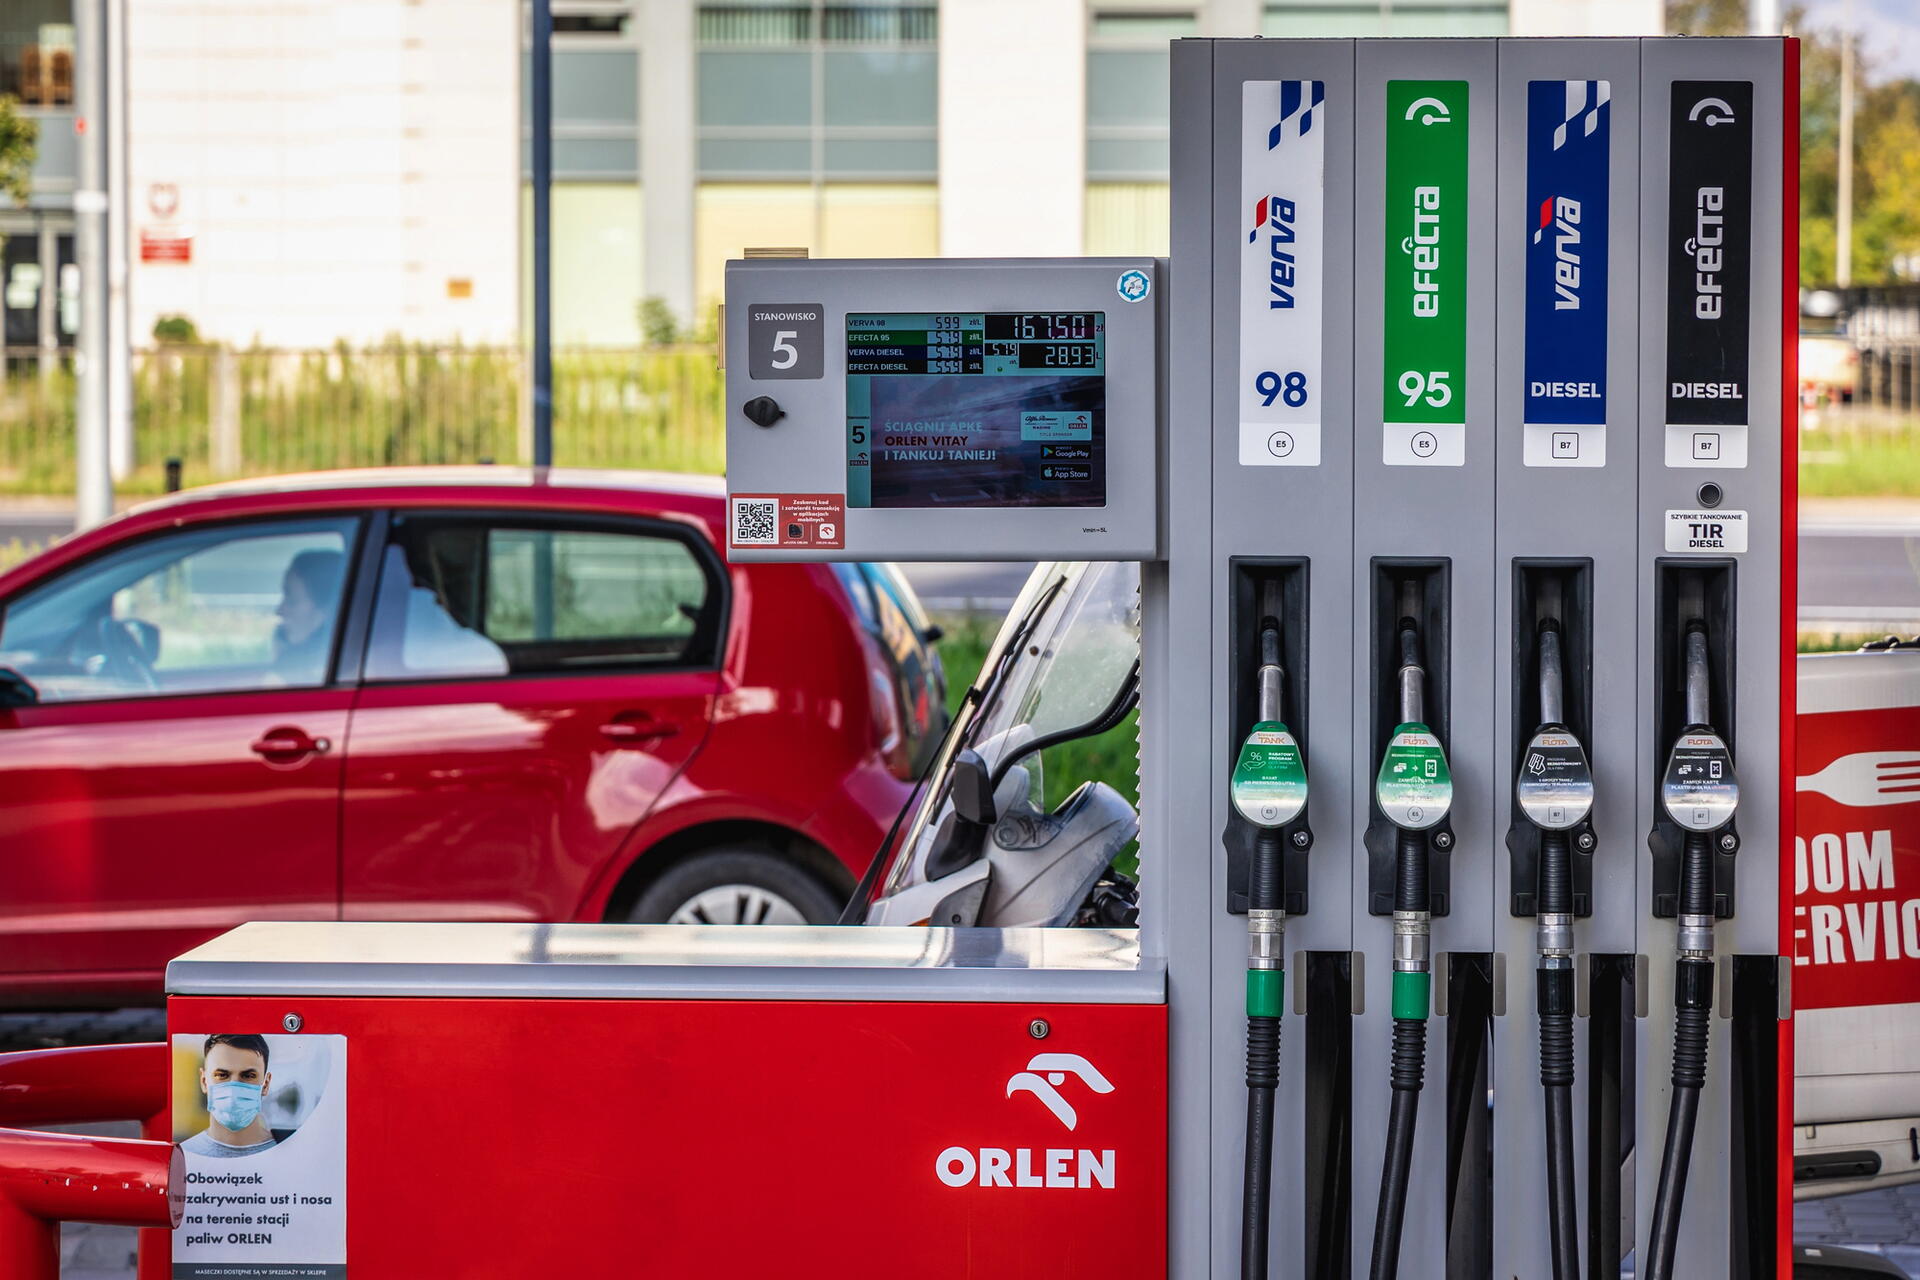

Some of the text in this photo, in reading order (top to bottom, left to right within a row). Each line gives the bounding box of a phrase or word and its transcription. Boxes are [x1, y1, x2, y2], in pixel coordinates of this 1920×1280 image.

[1270, 196, 1295, 310] verva
[1555, 196, 1581, 310] verva
[754, 312, 817, 321] STANOWISKO
[848, 319, 875, 327] VERVA
[771, 330, 798, 370] 5
[848, 348, 905, 356] VERVA DIESEL
[848, 363, 909, 371] EFECTA DIESEL
[1255, 371, 1308, 408] 98
[1398, 370, 1452, 408] 95
[1531, 381, 1601, 398] DIESEL
[1671, 382, 1743, 399] DIESEL
[852, 425, 866, 444] 5
[884, 436, 969, 446] ORLEN VITAY
[1275, 440, 1287, 448] E5
[1419, 440, 1430, 448] E5
[1560, 441, 1571, 449] B7
[1700, 442, 1712, 450] B7
[892, 450, 944, 461] TANKUJ
[948, 449, 996, 461] TANIEJ!
[1688, 523, 1723, 539] TIR
[1689, 540, 1724, 548] DIESEL
[935, 1146, 1116, 1189] ORLEN
[186, 1172, 263, 1187] Obowiązek
[186, 1193, 266, 1207] zakrywania
[270, 1194, 290, 1205] ust
[293, 1193, 297, 1205] i
[301, 1196, 332, 1205] nosa
[186, 1213, 290, 1227] na terenie stacji
[186, 1232, 272, 1247] paliw ORLEN
